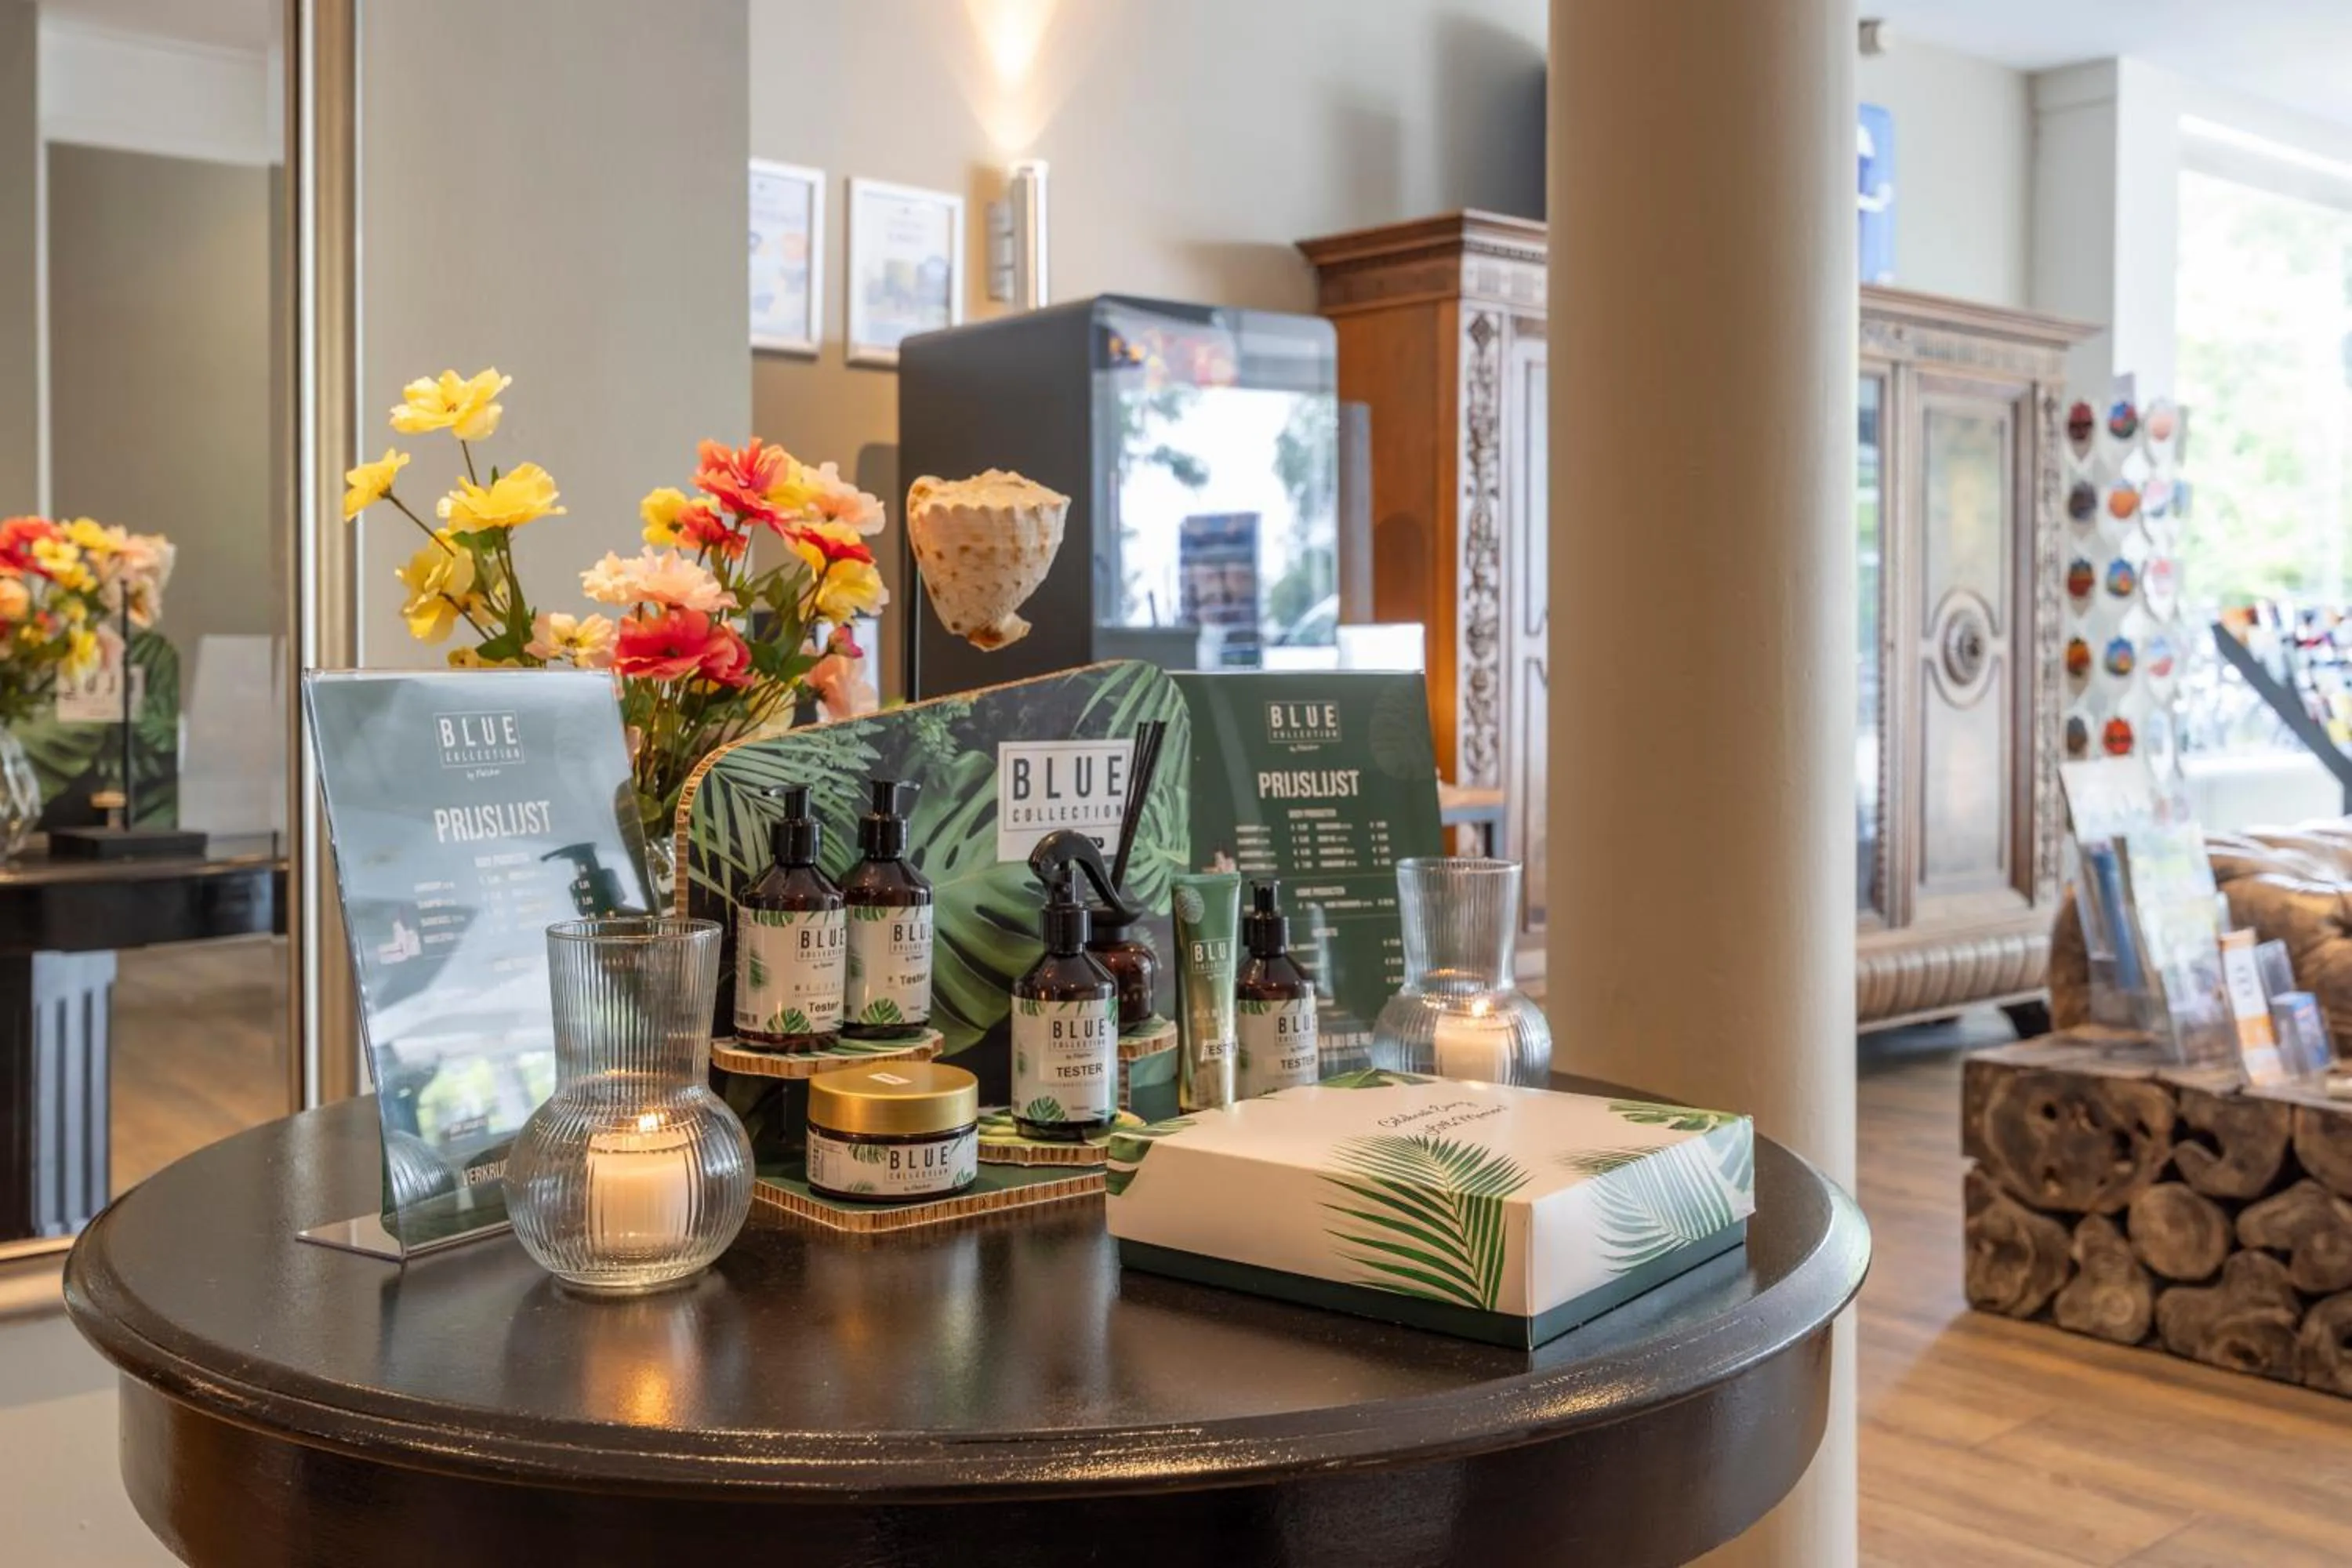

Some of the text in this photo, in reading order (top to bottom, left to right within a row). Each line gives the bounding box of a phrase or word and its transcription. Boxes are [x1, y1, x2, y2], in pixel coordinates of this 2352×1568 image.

[1270, 705, 1337, 728] BLUE
[439, 716, 517, 748] BLUE
[445, 748, 521, 763] COLLECTION
[1013, 755, 1122, 800] BLUE
[1258, 770, 1360, 799] PRIJSLIJST
[434, 800, 550, 844] PRIJSLIJST
[1013, 804, 1123, 822] COLLECTION
[1194, 942, 1227, 963] BLU
[808, 1001, 840, 1014] Tester
[1053, 1018, 1105, 1039] BLUE
[1055, 1062, 1103, 1078] TESTER
[890, 1145, 949, 1170] BLUE
